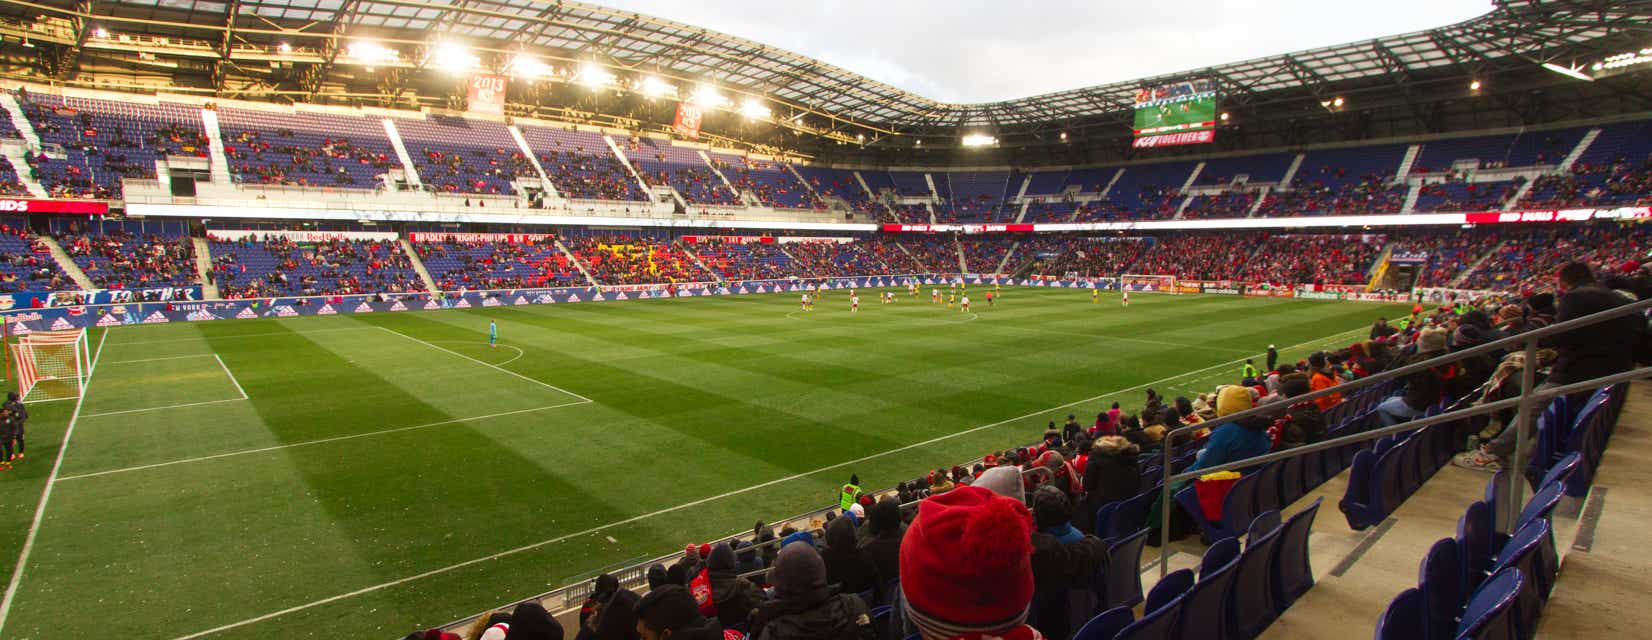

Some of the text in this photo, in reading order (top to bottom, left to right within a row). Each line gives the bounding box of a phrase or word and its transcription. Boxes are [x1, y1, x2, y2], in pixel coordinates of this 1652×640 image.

[473, 74, 504, 91] 2013
[1498, 211, 1554, 222] RED BULLS
[415, 232, 447, 241] BRADLEY
[449, 232, 508, 242] RIGHT-PHILLIPS
[108, 287, 194, 303] TOETHER
